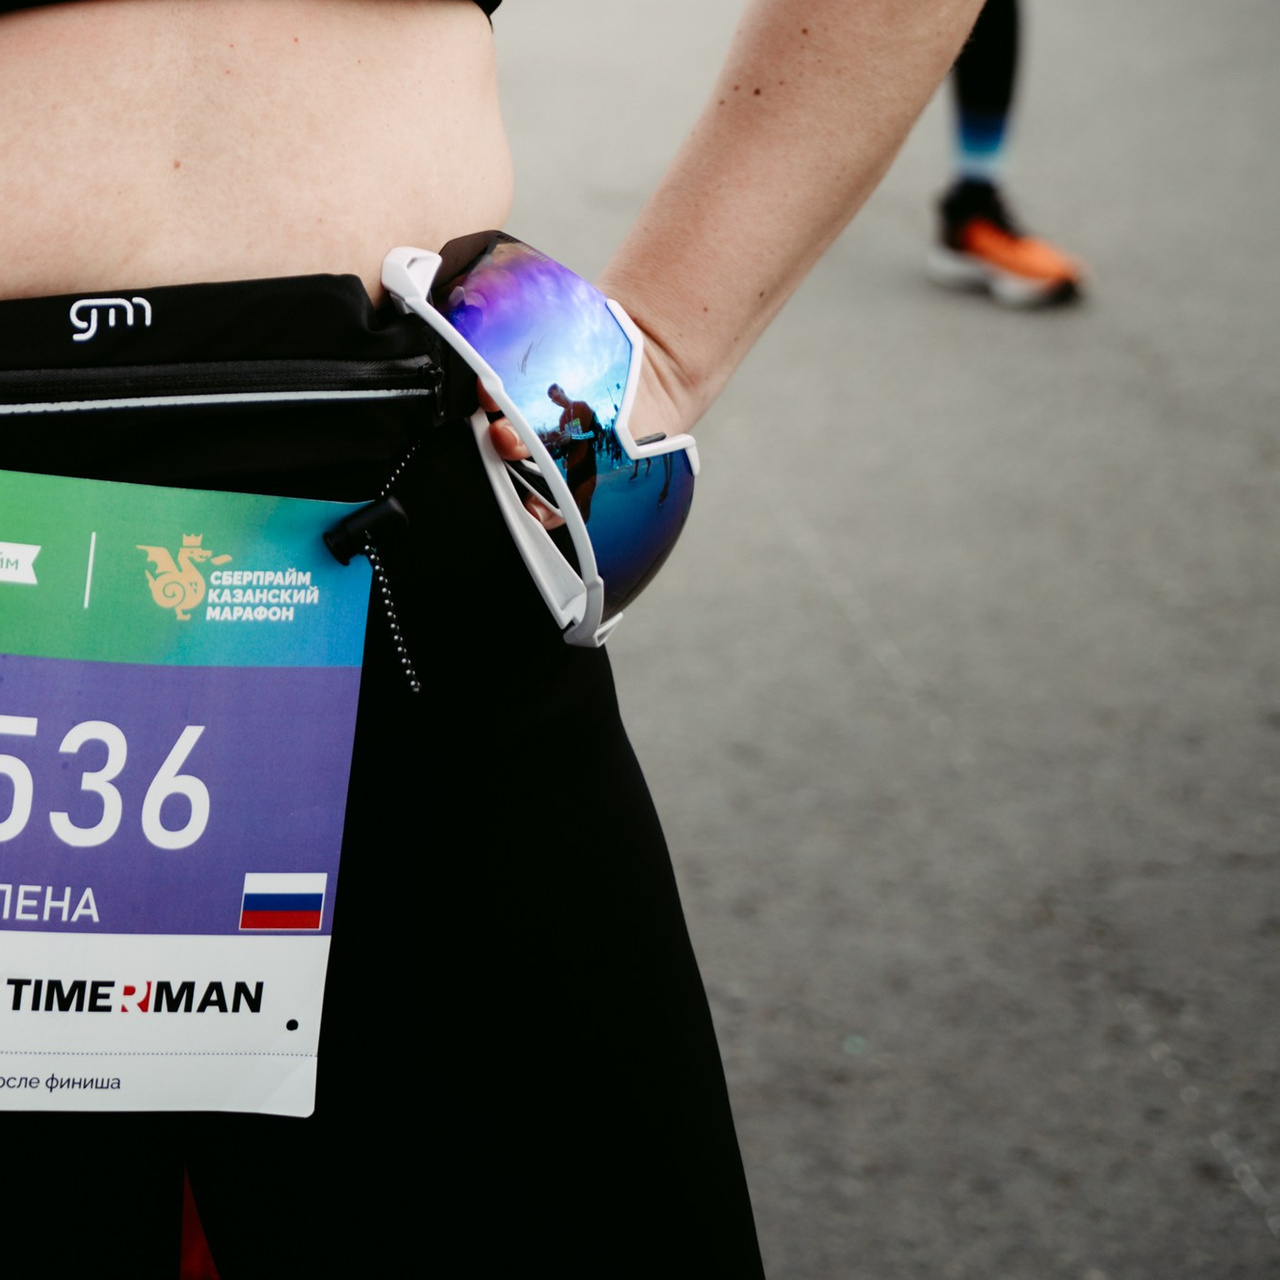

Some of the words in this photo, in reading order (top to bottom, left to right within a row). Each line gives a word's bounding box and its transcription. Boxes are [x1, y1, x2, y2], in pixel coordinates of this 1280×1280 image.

[209, 567, 312, 586] СБЕРПРАЙМ
[207, 585, 320, 605] КАЗАНСКИЙ
[205, 605, 295, 621] МАРАФОН
[6, 978, 264, 1013] TIMERMAN
[45, 1072, 122, 1093] финиша
